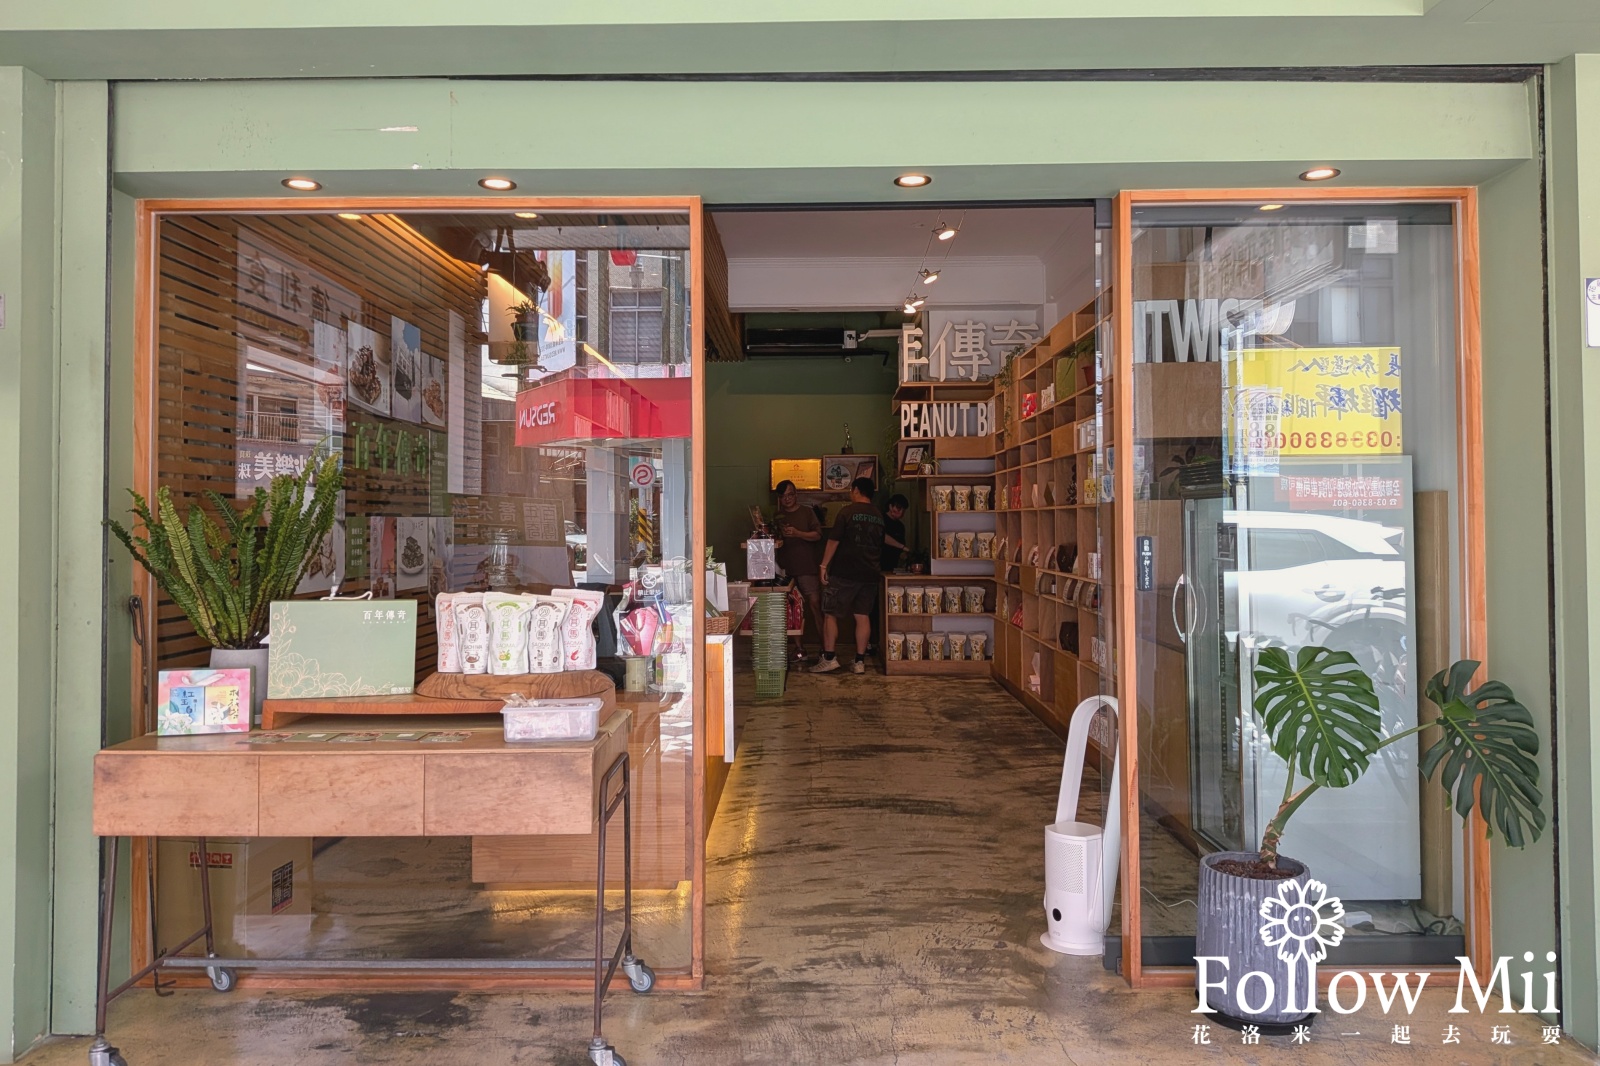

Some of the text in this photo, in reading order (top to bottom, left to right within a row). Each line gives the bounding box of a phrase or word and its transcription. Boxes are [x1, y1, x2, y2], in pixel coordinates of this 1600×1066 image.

[901, 402, 970, 438] PEANUT
[362, 609, 407, 621] 百年傳奇
